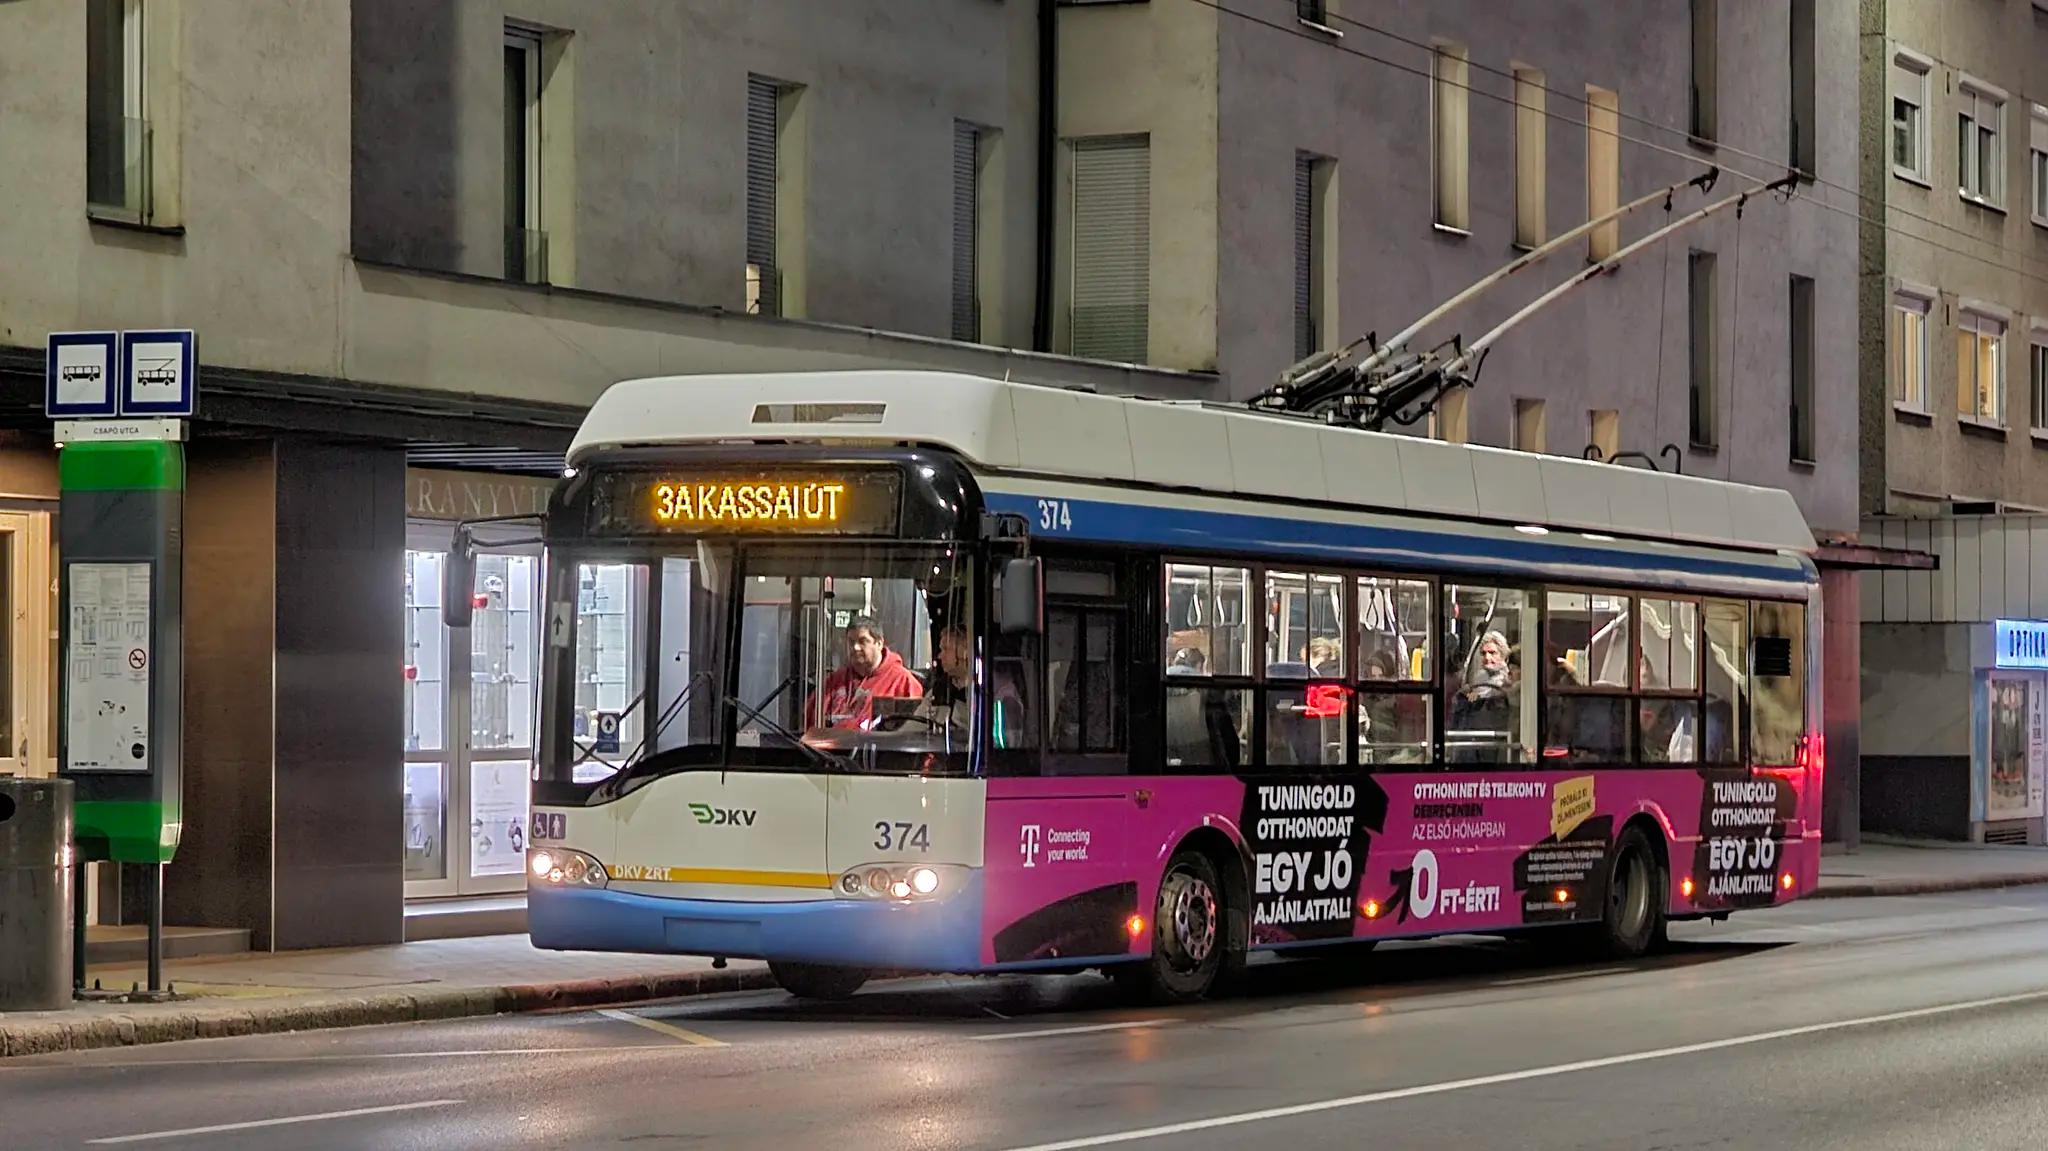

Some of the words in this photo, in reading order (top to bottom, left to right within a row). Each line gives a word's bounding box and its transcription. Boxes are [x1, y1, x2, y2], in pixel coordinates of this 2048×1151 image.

[407, 478, 553, 517] RANYVI
[657, 485, 694, 520] 3A
[698, 485, 799, 520] KASSAI
[803, 482, 844, 520] ÚT
[1038, 499, 1072, 531] 374
[1258, 785, 1355, 811] TUNINGOLD
[1413, 782, 1458, 799] OTTHONI
[1459, 782, 1479, 798] NET
[1480, 778, 1491, 798] ÉS
[1492, 782, 1533, 798] TELEKOM
[1534, 782, 1546, 797] TV
[1712, 782, 1777, 804] TUNINGOLD
[714, 808, 757, 827] DKV
[1257, 816, 1354, 840] OTTHONODAT
[1412, 823, 1426, 840] AZ
[1426, 820, 1452, 839] ELSŐ
[1452, 819, 1506, 838] HÓNAPBAN
[1711, 808, 1776, 827] OTTHONODAT
[874, 821, 930, 852] 374
[1048, 828, 1090, 845] Connecting
[1709, 838, 1747, 870] EGY
[1748, 826, 1775, 870] JÓ
[1048, 849, 1064, 864] your
[1065, 846, 1088, 860] world.
[1255, 851, 1312, 894] EGY
[1313, 839, 1352, 891] JÓ
[615, 864, 642, 879] DKV
[1410, 849, 1438, 919] 0
[1440, 880, 1500, 915] FT-ÉRT!
[1708, 872, 1773, 896] AJÁNLATTAL!
[1254, 895, 1352, 925] AJÁNLATTAL!
